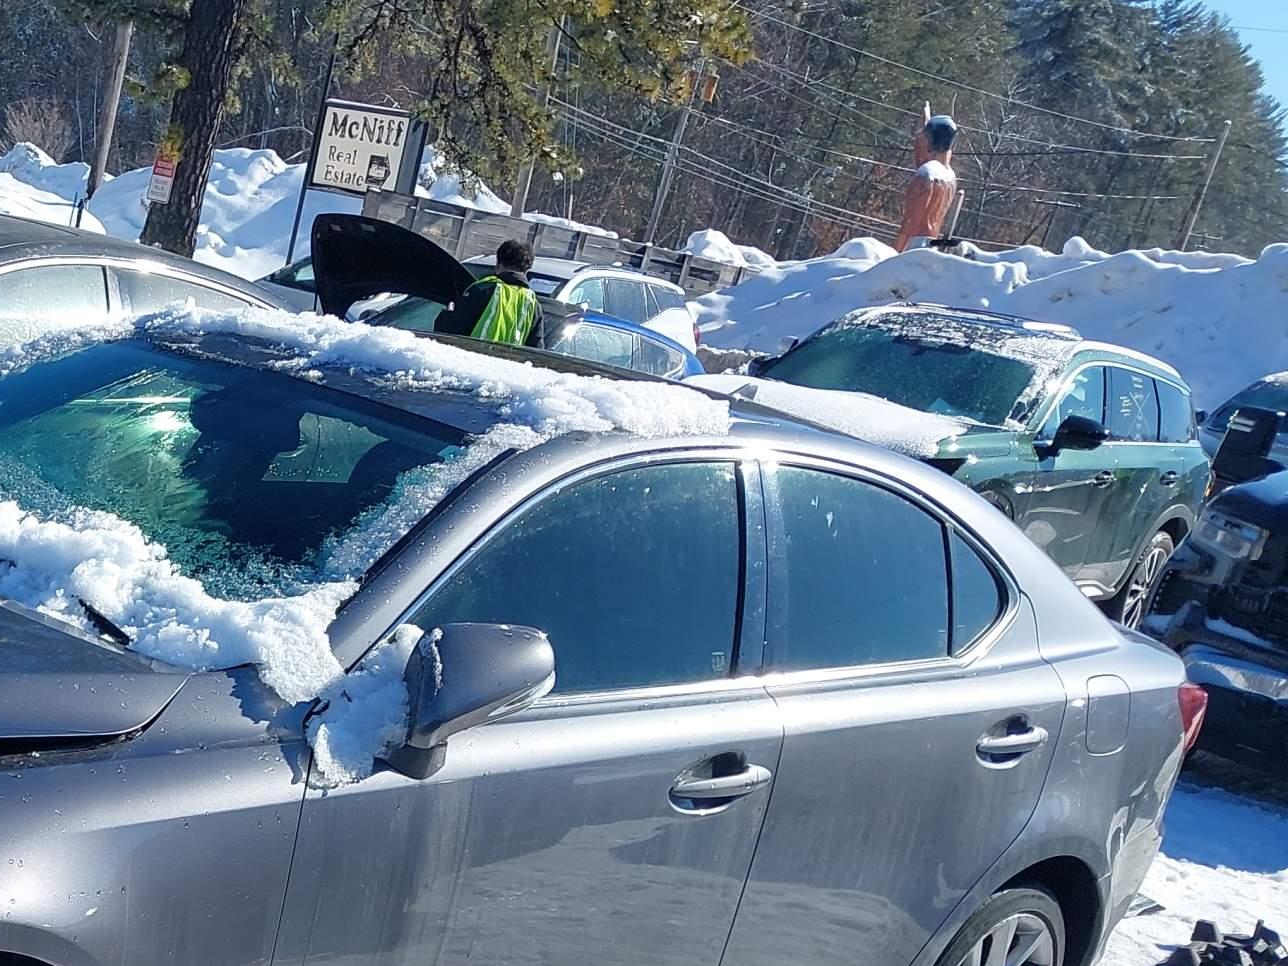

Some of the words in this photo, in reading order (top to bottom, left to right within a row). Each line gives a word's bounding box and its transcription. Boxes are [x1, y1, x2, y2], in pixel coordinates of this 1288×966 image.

[328, 111, 405, 147] McNiff
[328, 145, 357, 165] Real
[323, 164, 364, 186] Estate
